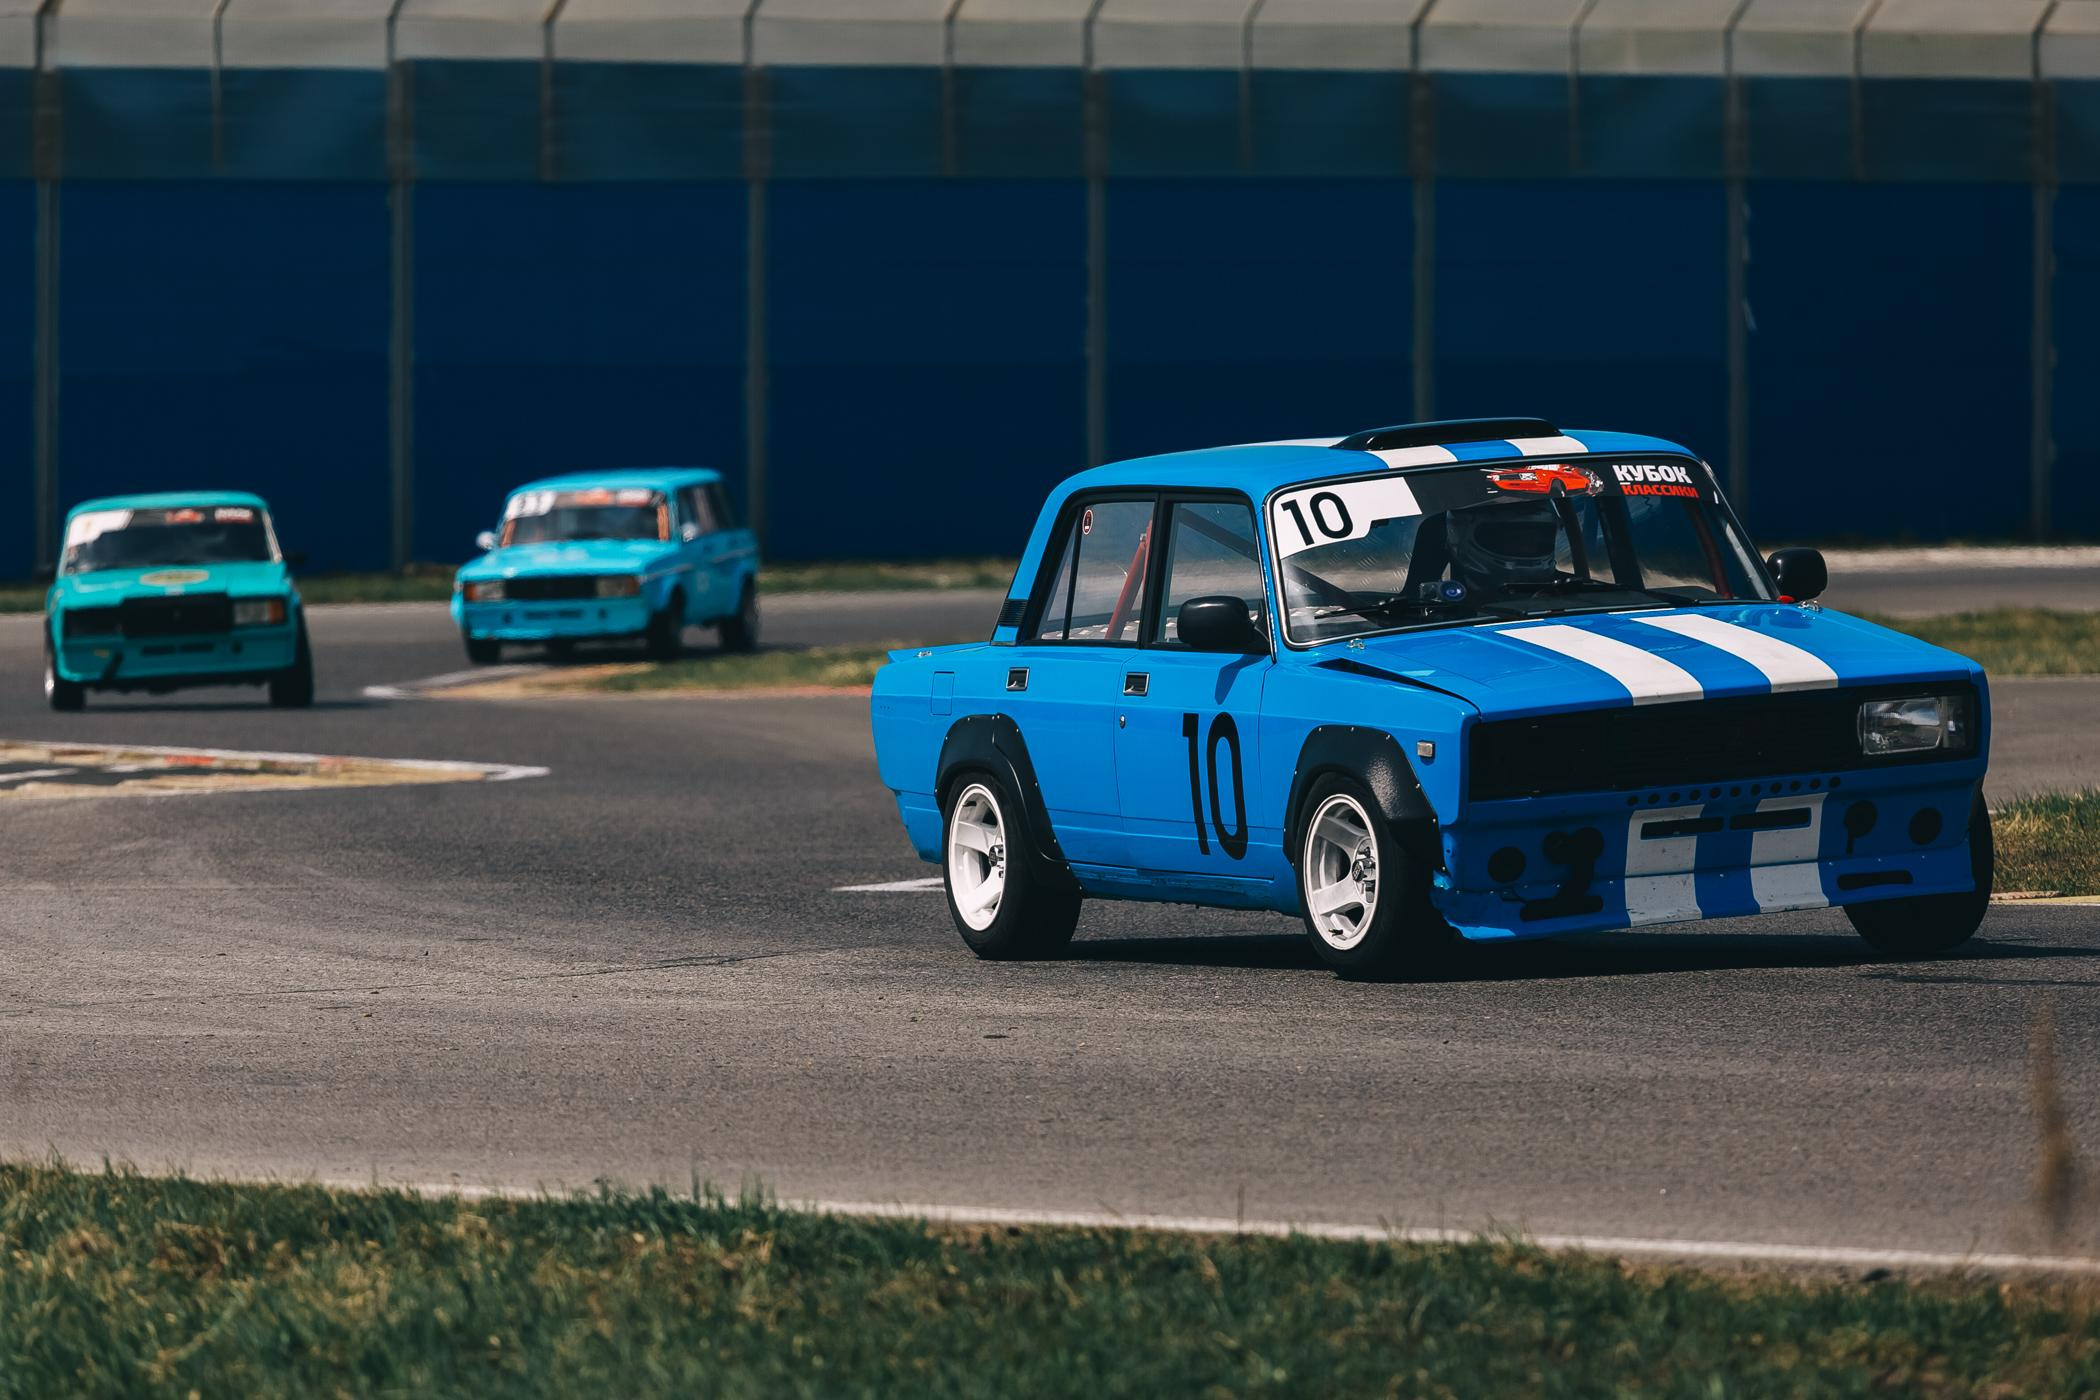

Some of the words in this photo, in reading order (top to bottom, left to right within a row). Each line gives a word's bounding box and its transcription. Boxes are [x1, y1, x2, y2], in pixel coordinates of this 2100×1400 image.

[1612, 464, 1693, 484] КУБОК
[1620, 484, 1700, 498] КЛАССИКИ
[1280, 491, 1354, 546] 10
[1182, 711, 1249, 861] 10
